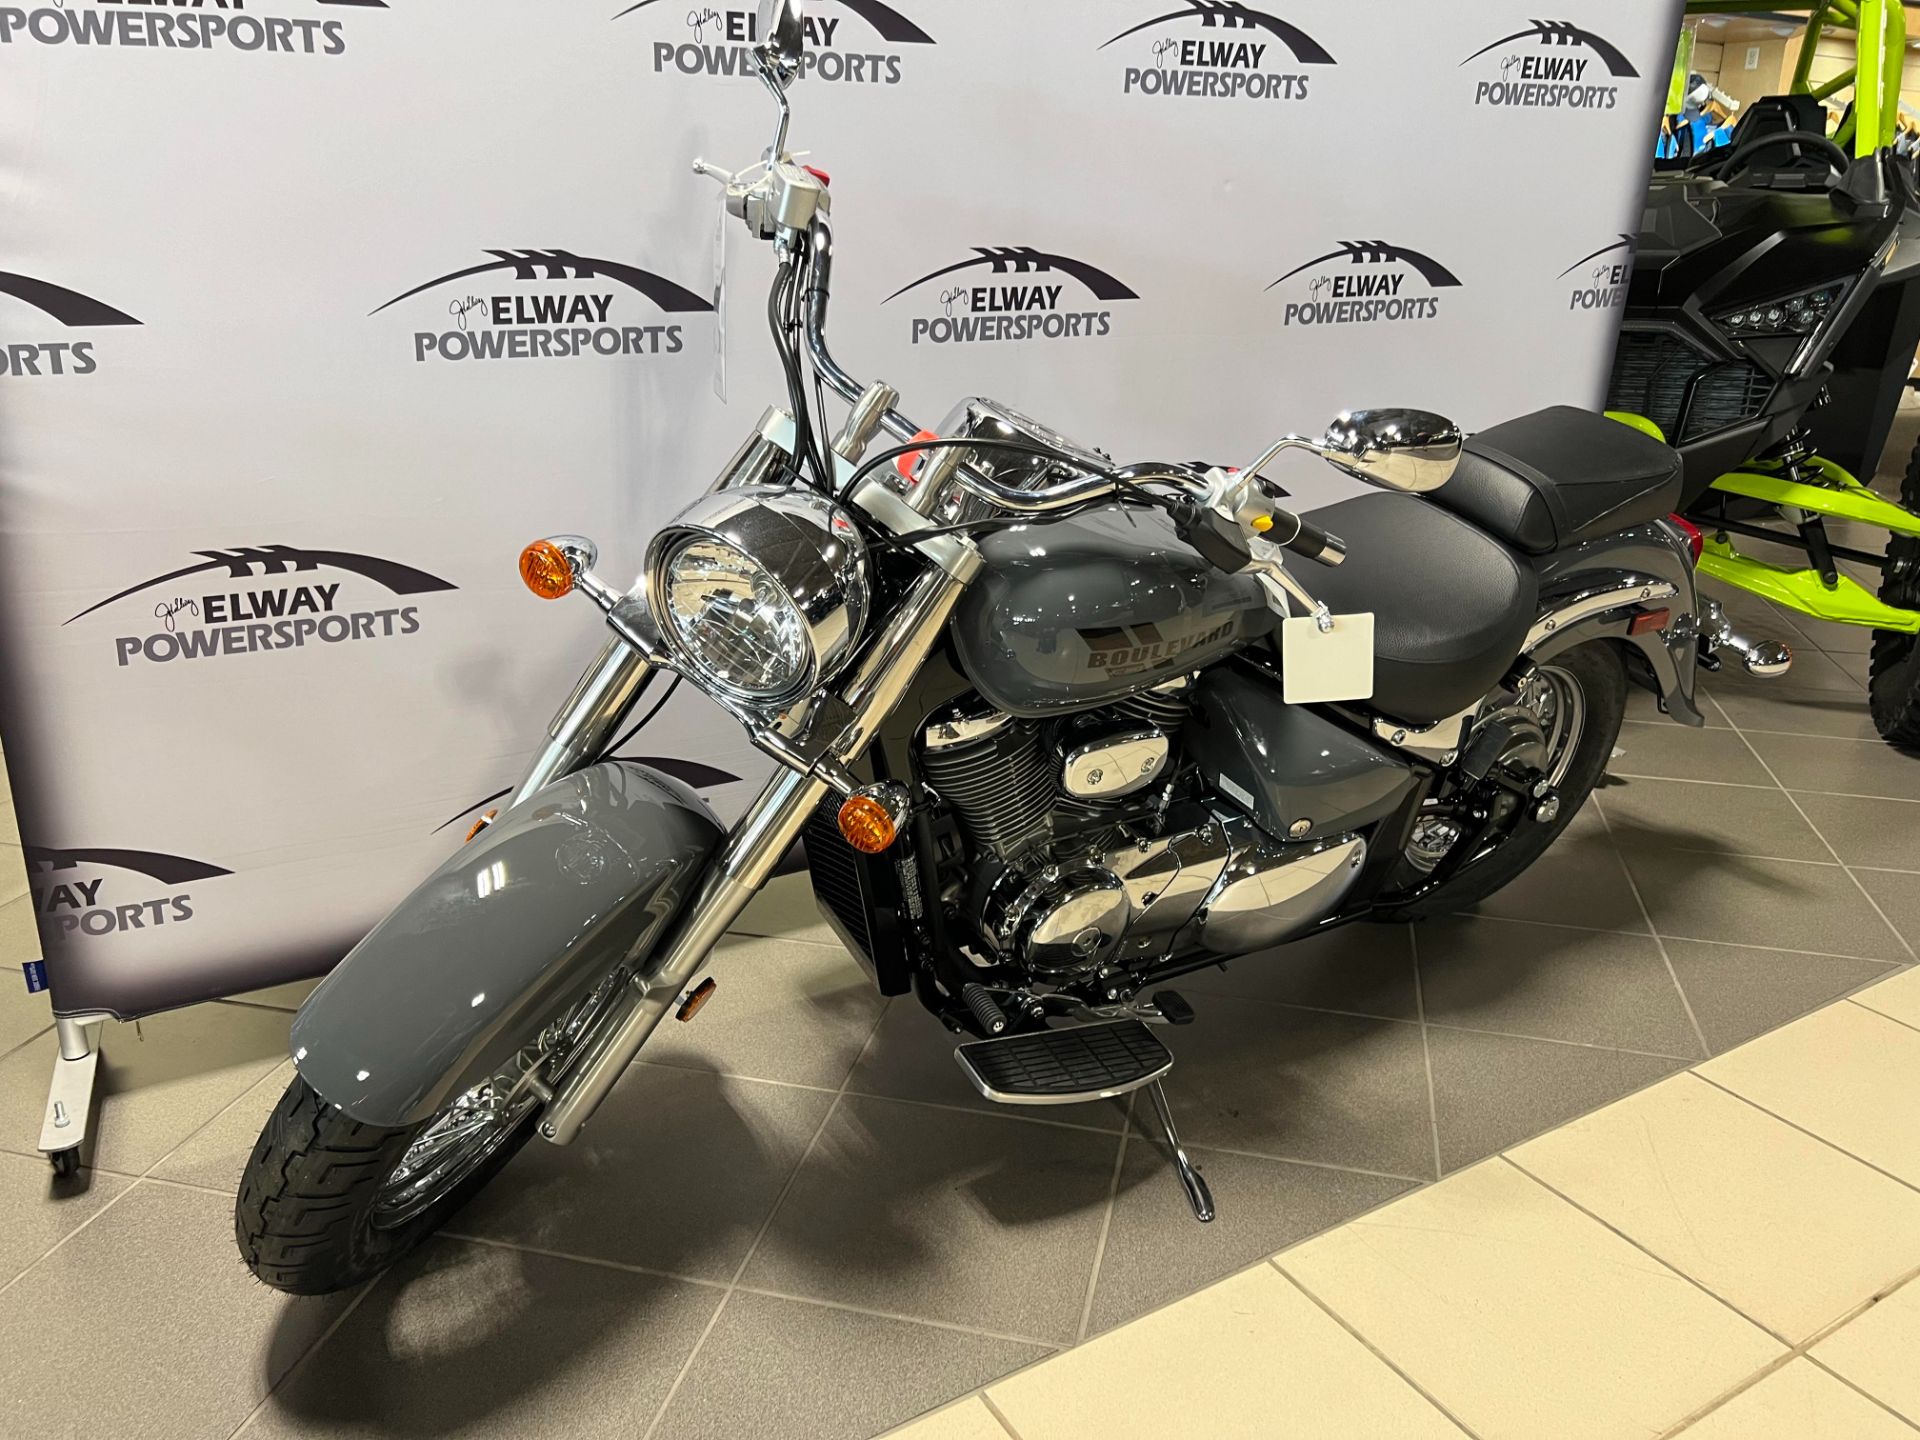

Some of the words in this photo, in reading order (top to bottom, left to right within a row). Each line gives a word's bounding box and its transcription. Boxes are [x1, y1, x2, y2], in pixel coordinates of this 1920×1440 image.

[0, 7, 346, 55] POWERSPORTS
[726, 11, 839, 47] ELAY
[653, 42, 901, 84] POWEPORTS
[1180, 40, 1266, 69] ELWAY
[1520, 56, 1588, 81] ELWAY
[1124, 68, 1309, 100] POWERSPORTS
[1475, 81, 1618, 109] POWERSPORTS
[971, 285, 1063, 313] ELWAY
[1332, 274, 1404, 298] ELWAY
[491, 294, 614, 325] ELWAY
[1284, 297, 1439, 326] POWERSPORTS
[414, 325, 683, 362] POWERSPORTS
[912, 311, 1111, 344] POWERSPORTS
[202, 583, 340, 624] ELWAY
[115, 607, 420, 666] POWERSPORTS
[1088, 620, 1234, 668] BOULEVARD
